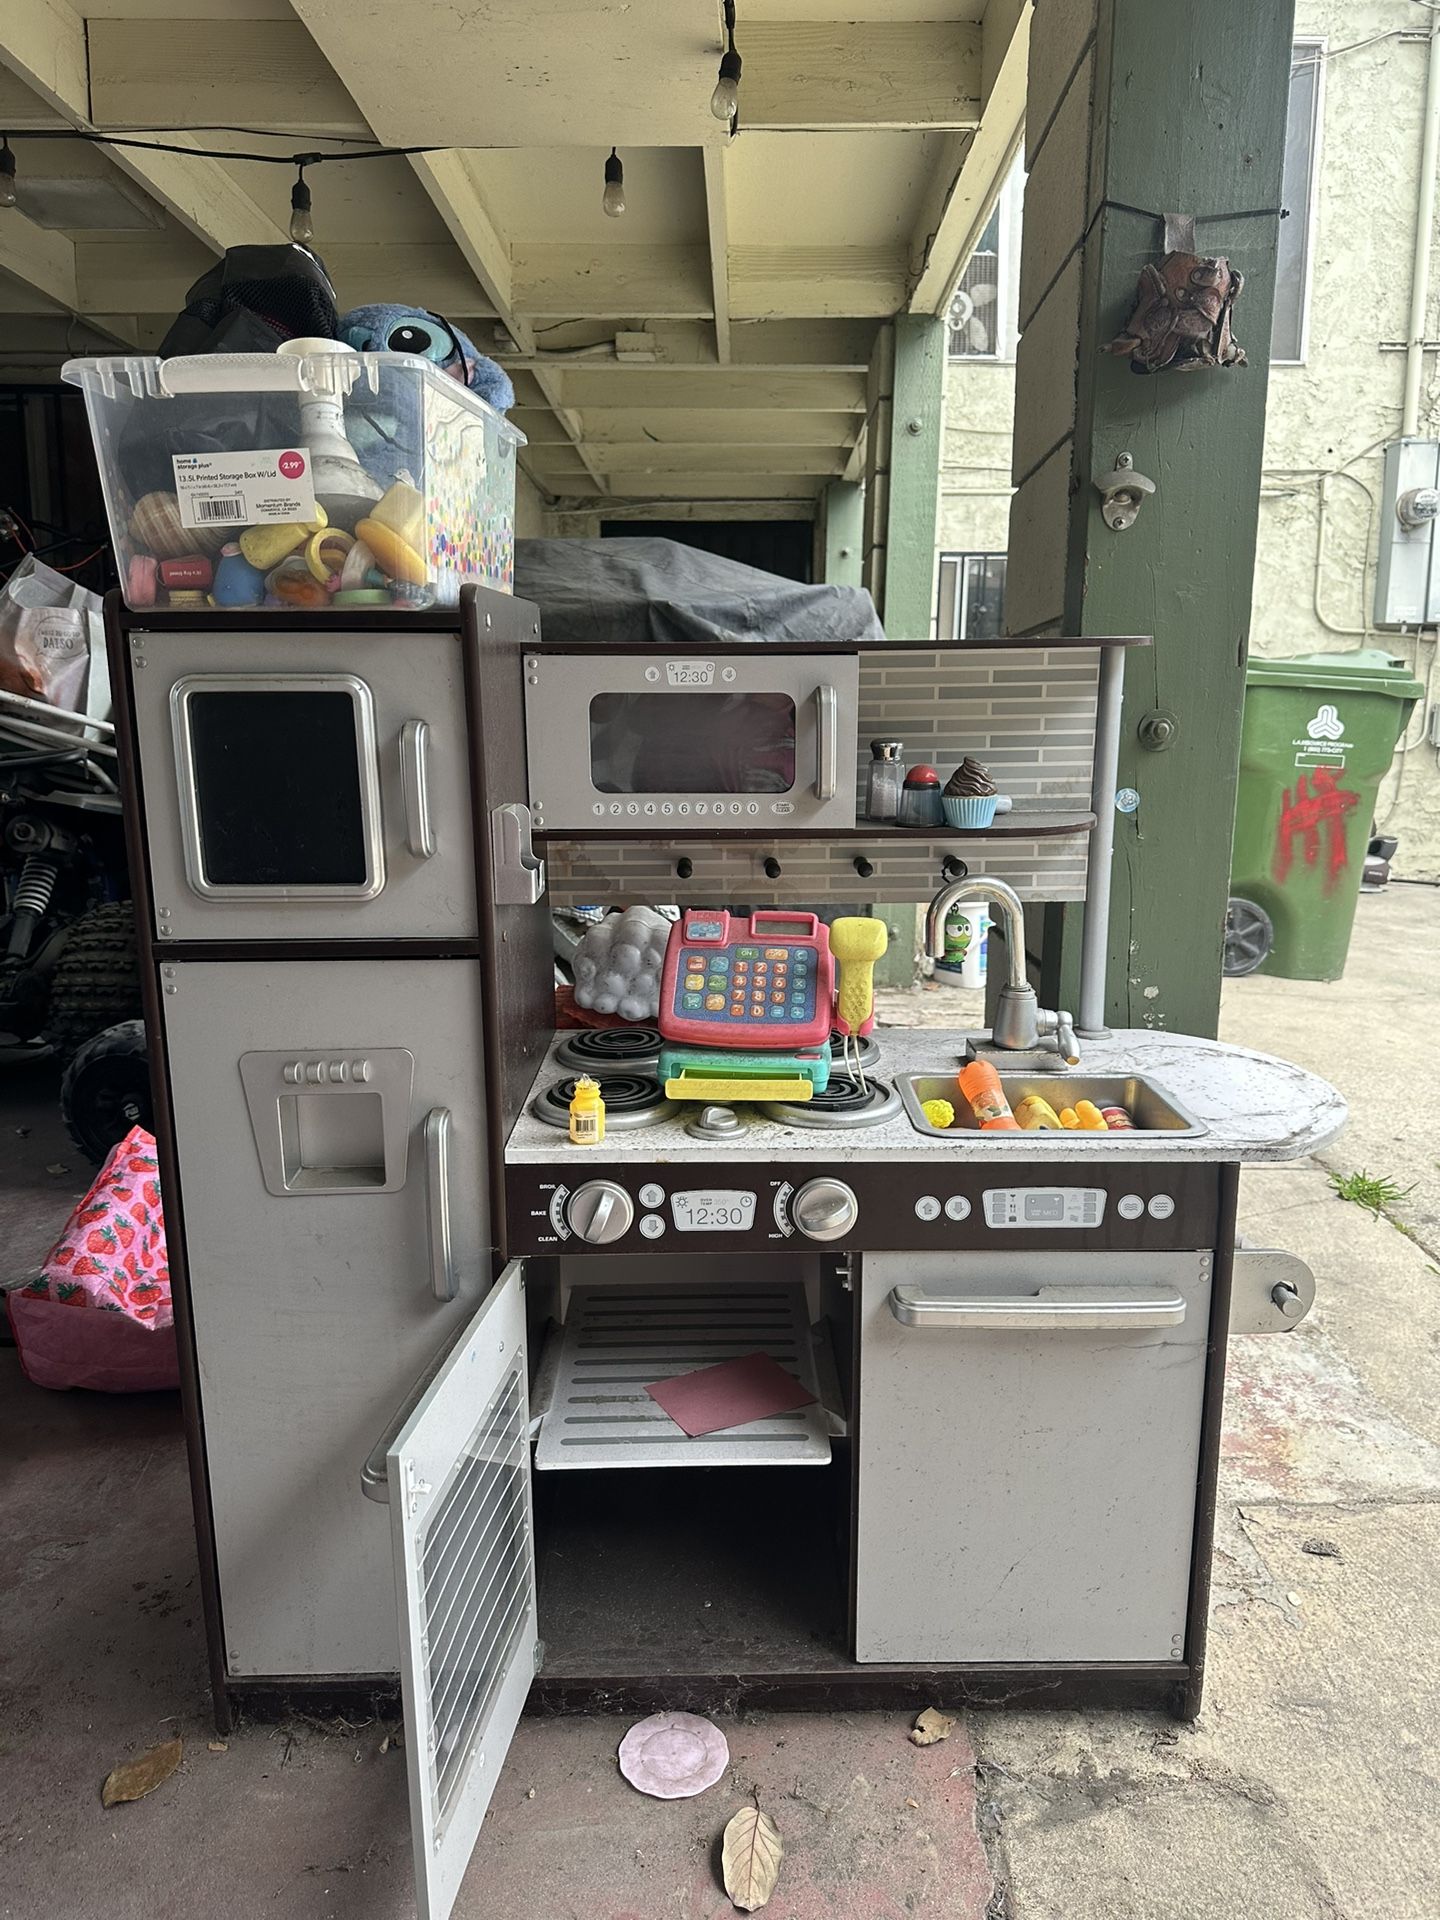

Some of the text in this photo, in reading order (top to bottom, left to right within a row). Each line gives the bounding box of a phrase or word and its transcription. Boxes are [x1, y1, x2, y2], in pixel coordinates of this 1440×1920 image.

[43, 637, 74, 650] DAISO
[675, 671, 708, 682] 12:30
[596, 804, 756, 813] 1 2 3 4 5 6 7 8 9 0
[686, 1208, 742, 1224] 12:30
